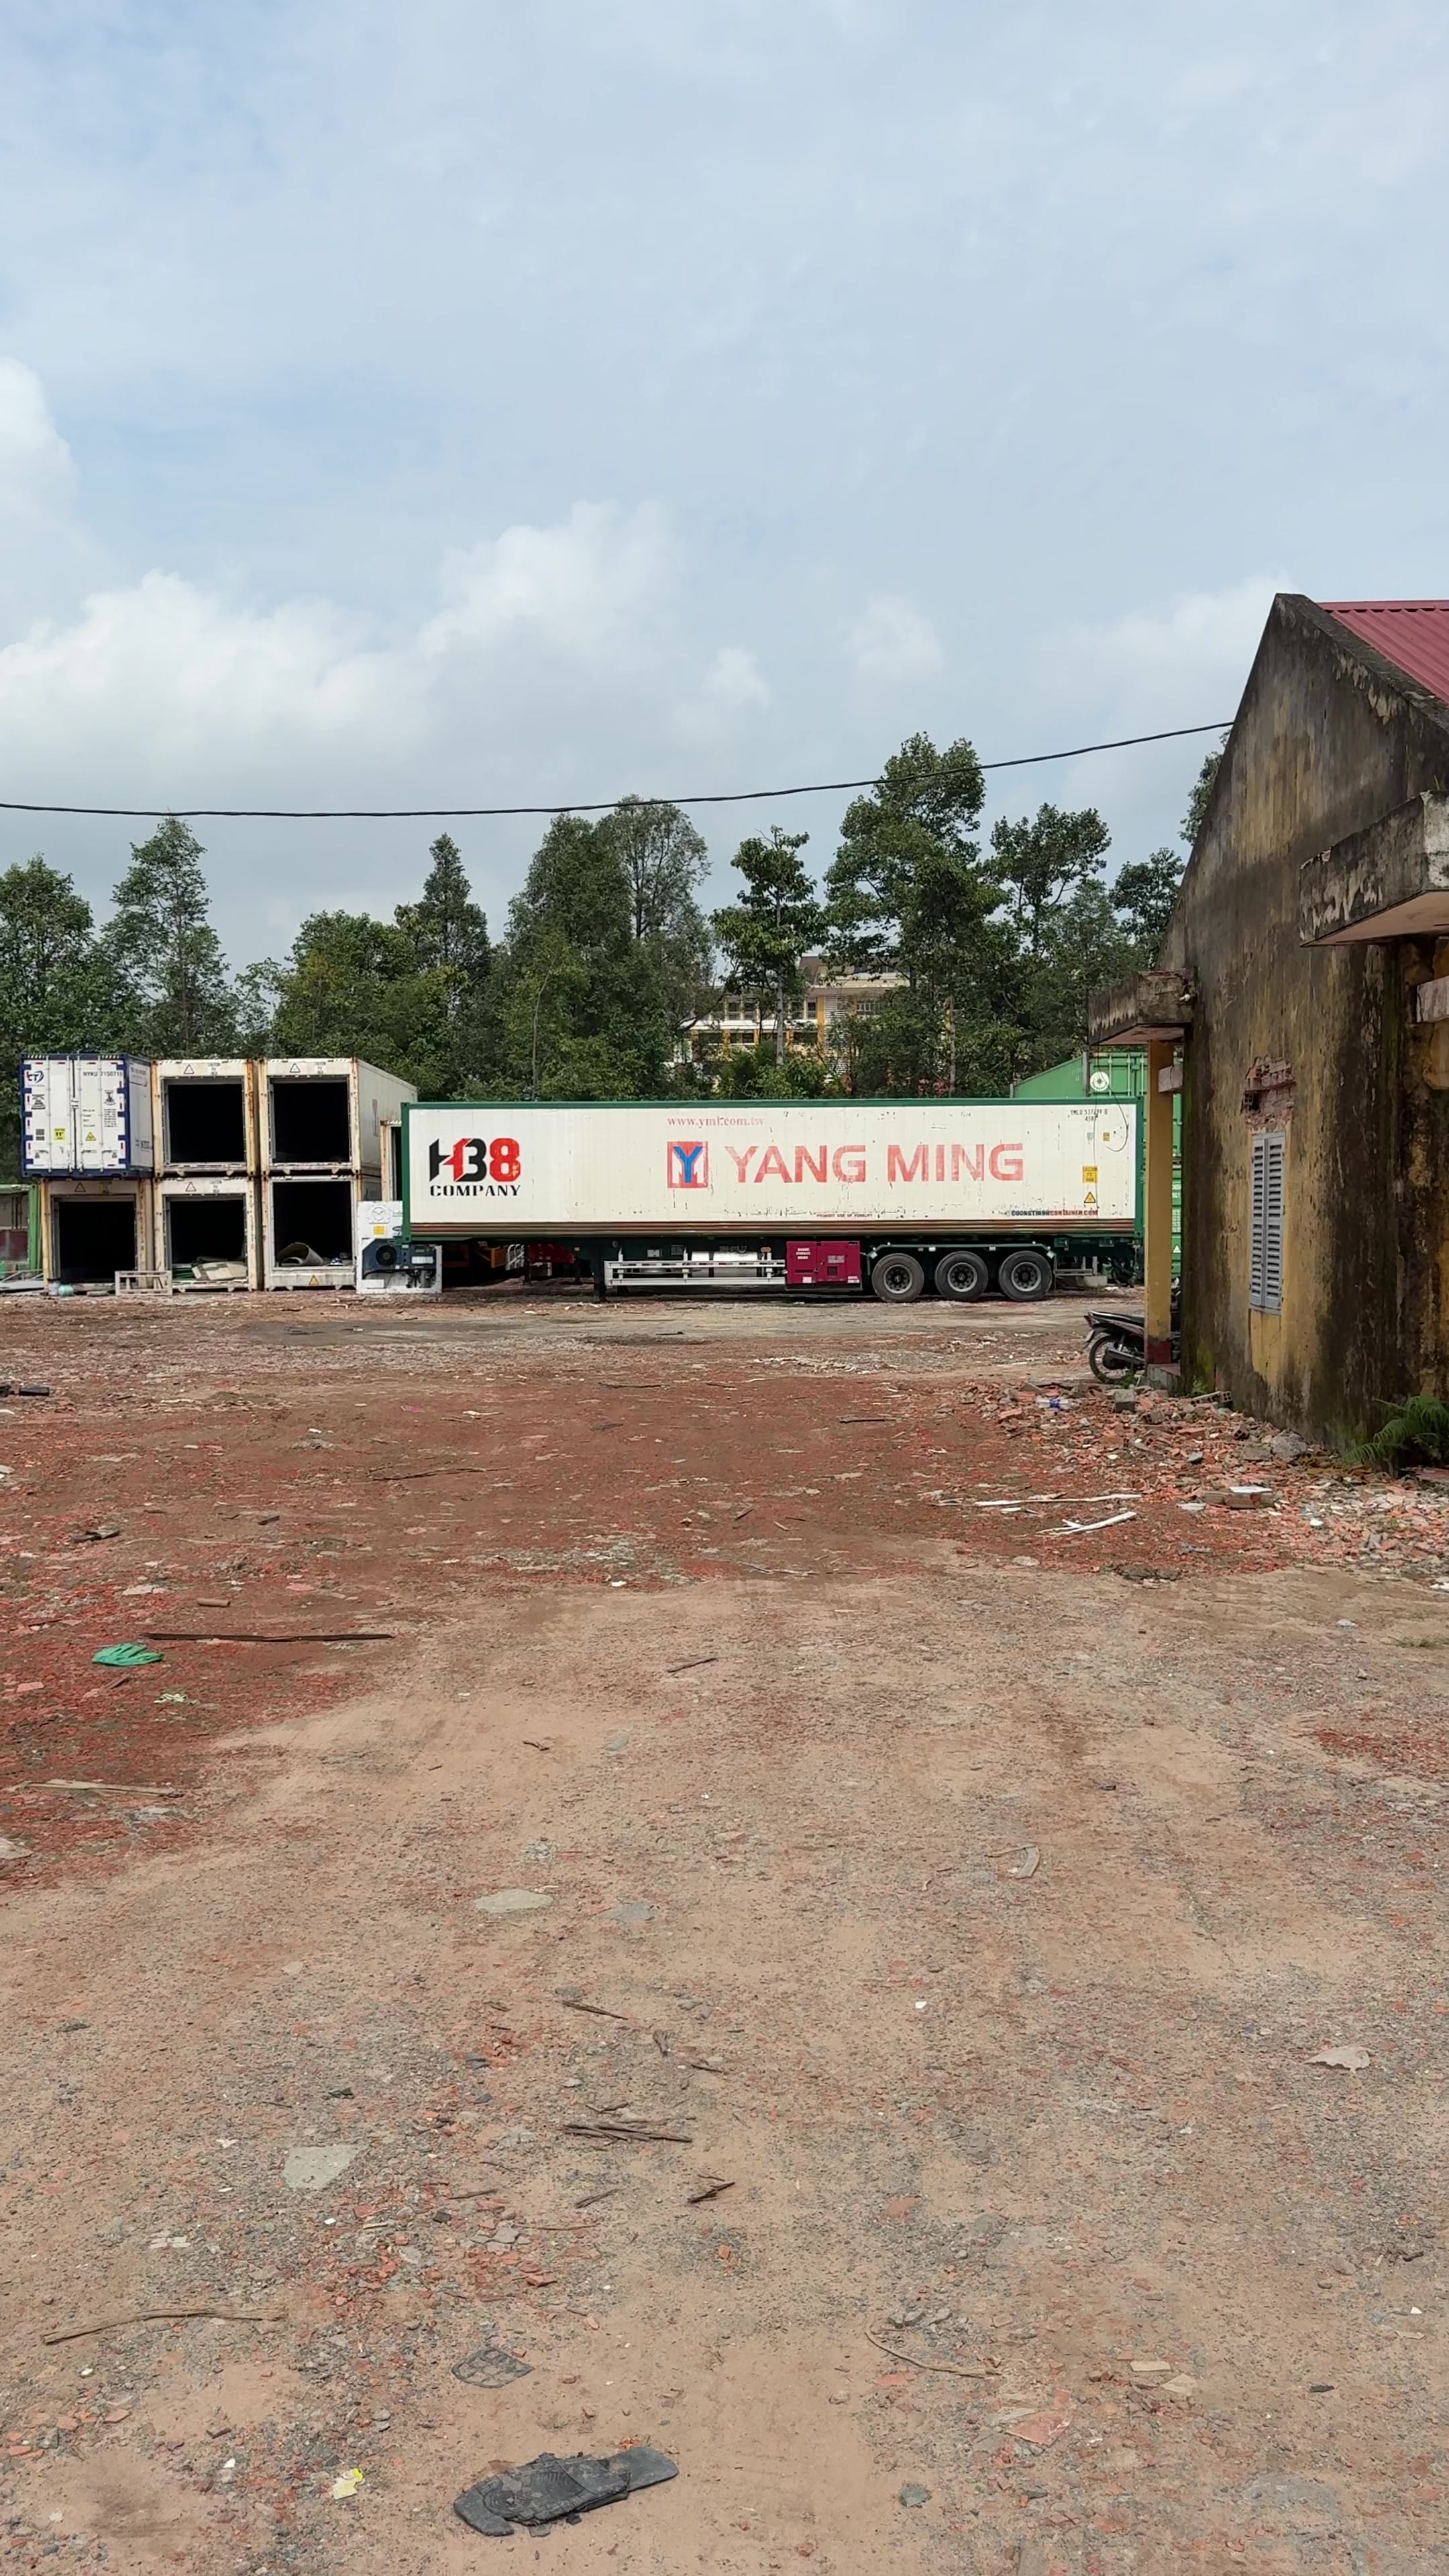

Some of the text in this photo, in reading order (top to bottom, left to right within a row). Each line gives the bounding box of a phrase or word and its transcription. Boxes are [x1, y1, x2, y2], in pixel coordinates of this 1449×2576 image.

[724, 1144, 866, 1183] YANG
[887, 1144, 1024, 1182] MING
[430, 1185, 521, 1197] COMPANY
